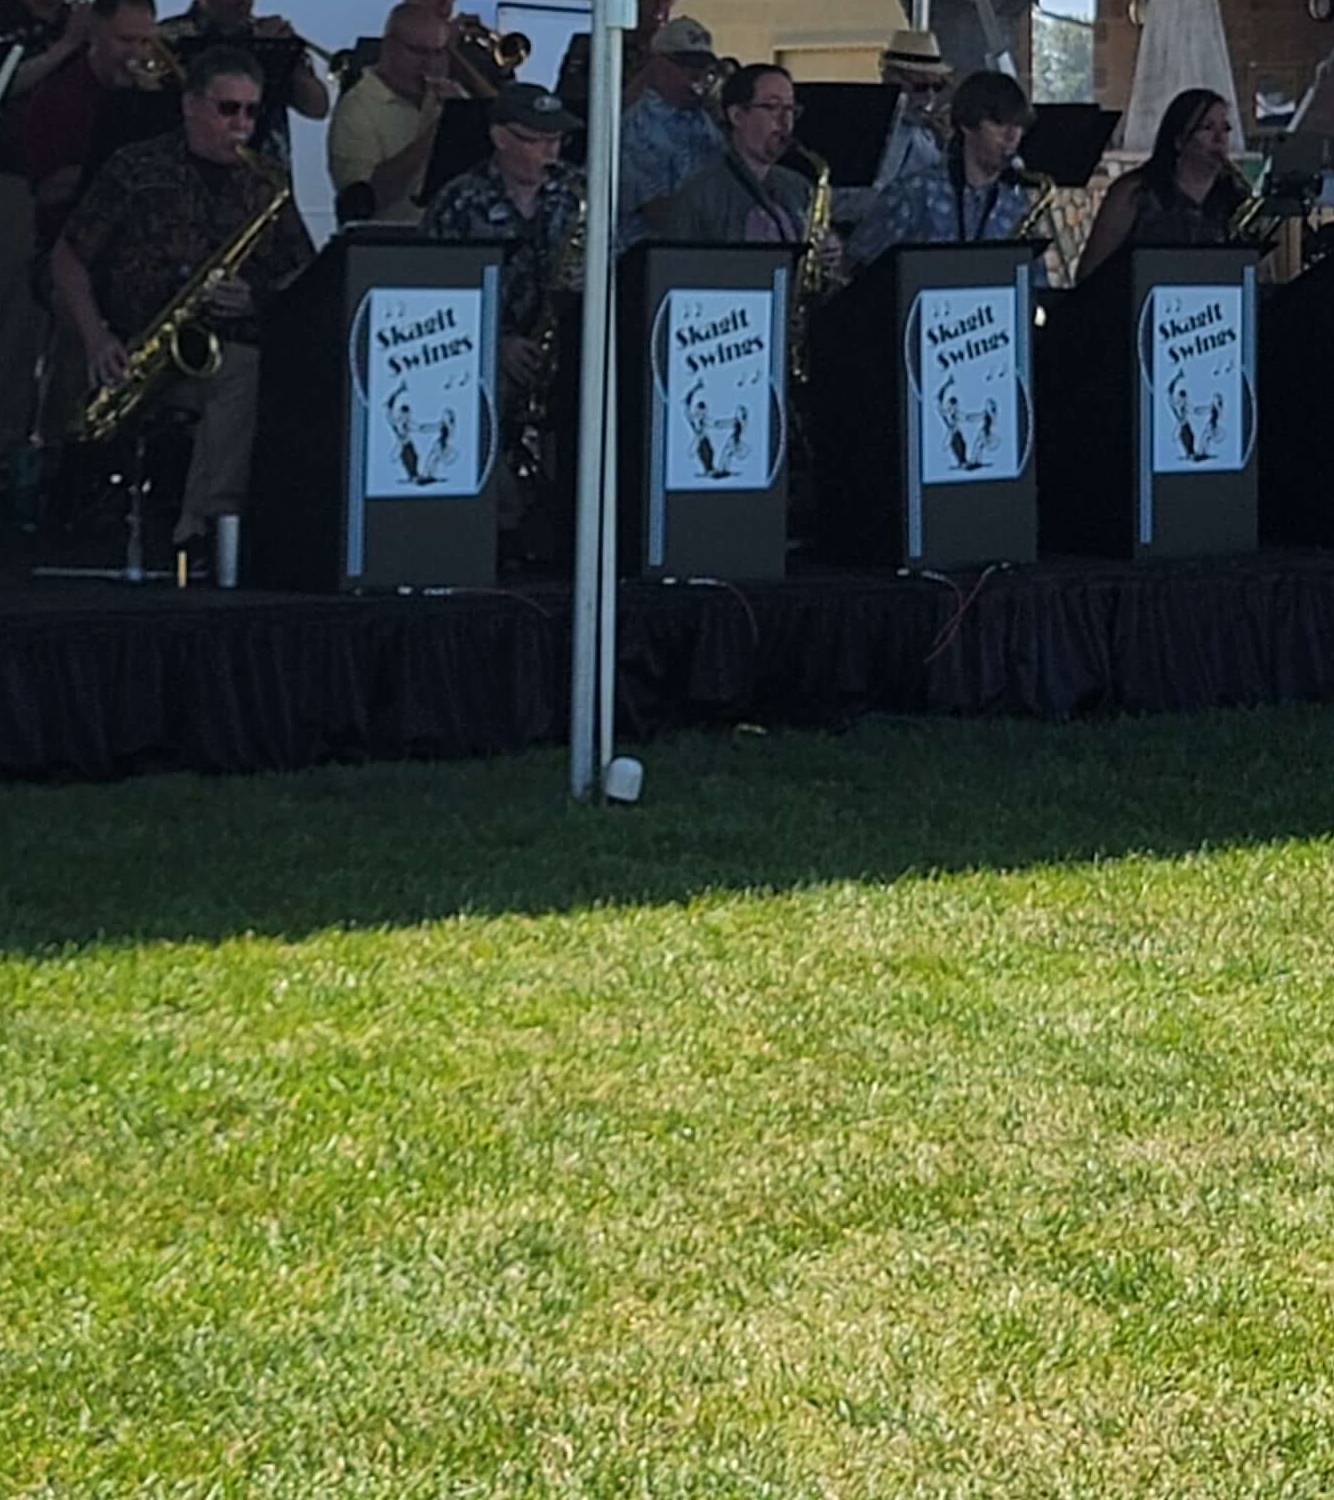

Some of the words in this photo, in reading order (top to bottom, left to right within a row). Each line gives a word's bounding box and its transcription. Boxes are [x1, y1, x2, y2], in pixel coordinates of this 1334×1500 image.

[376, 306, 457, 350] Skagit
[676, 307, 749, 350] Skagit
[926, 304, 995, 346] Skagit
[1158, 302, 1223, 342] Skagit
[388, 334, 474, 378] Swings
[685, 333, 765, 376] Swings
[936, 330, 1010, 371] Swings
[1167, 328, 1237, 365] Swings
